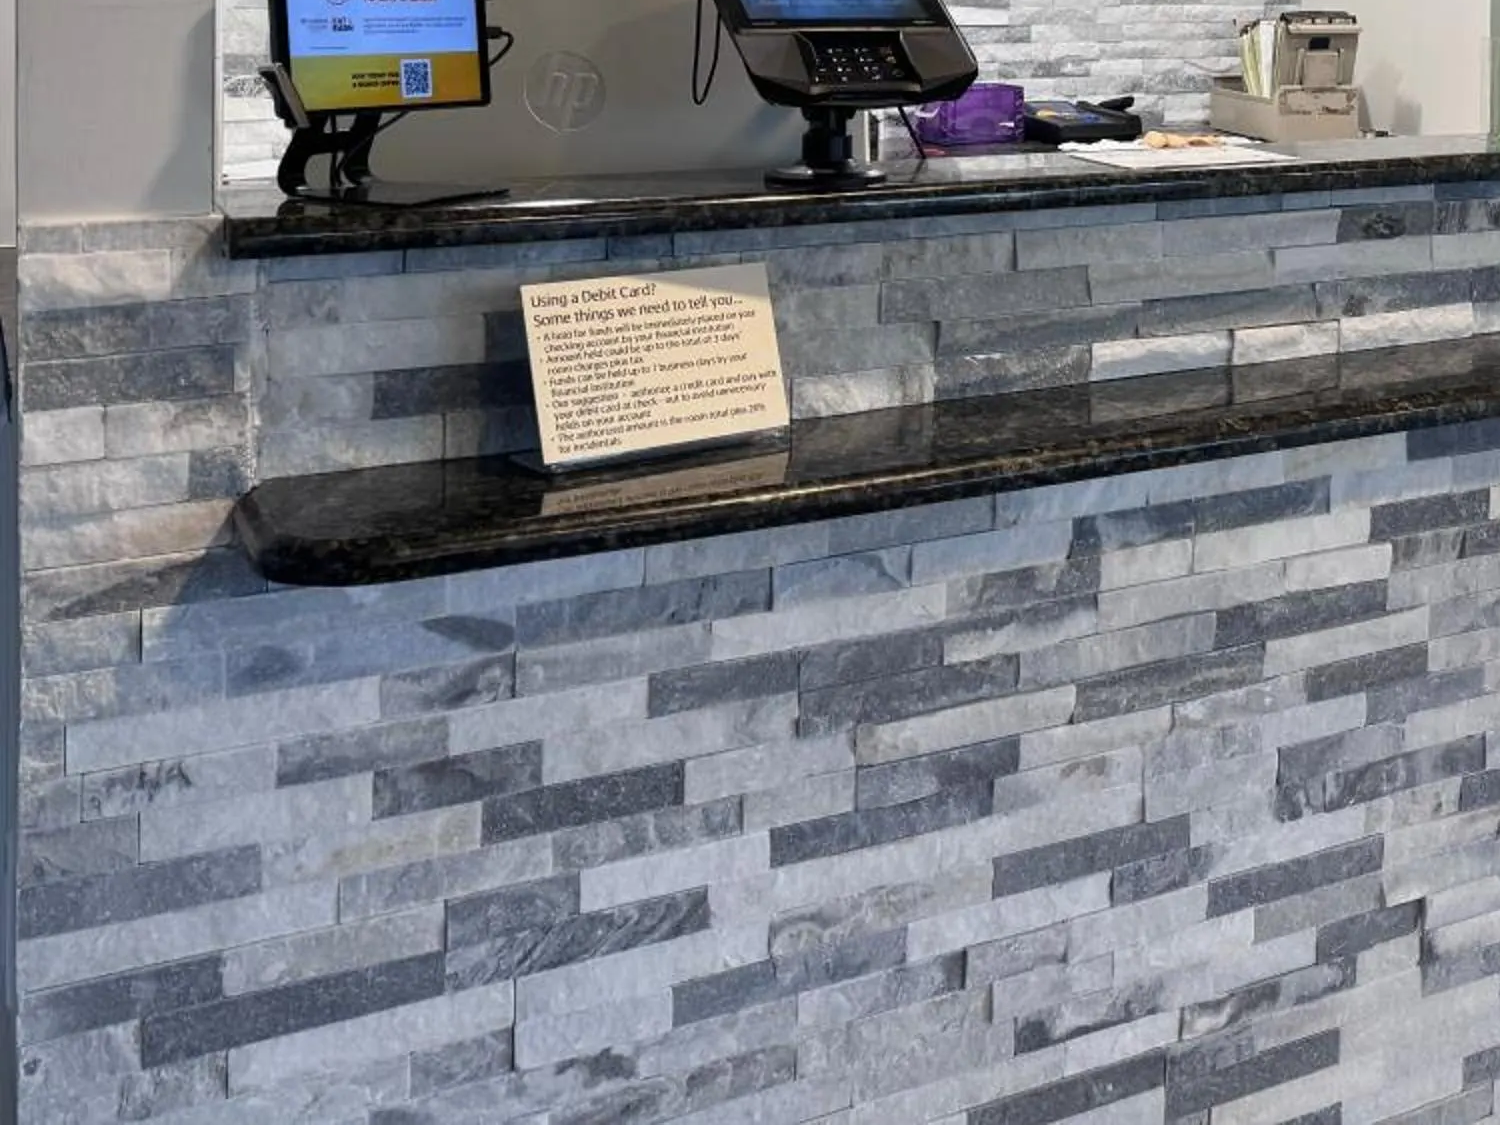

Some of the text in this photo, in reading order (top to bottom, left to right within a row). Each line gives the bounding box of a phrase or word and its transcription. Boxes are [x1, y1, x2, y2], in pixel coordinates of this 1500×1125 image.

[531, 293, 567, 308] Using
[581, 288, 616, 302] Debit
[619, 284, 657, 298] Card?
[533, 312, 570, 326] Some
[574, 307, 614, 324] things
[617, 307, 636, 316] we
[638, 300, 669, 314] need
[673, 300, 686, 310] to
[688, 296, 707, 308] tell
[631, 322, 641, 330] be
[697, 314, 723, 323] placed
[544, 342, 583, 352] checking
[655, 328, 690, 337] financial
[583, 350, 602, 358] held
[604, 347, 628, 355] could
[630, 344, 640, 352] be
[643, 344, 654, 352] up
[549, 376, 575, 385] Funds
[607, 369, 626, 377] held
[695, 357, 715, 368] days
[574, 361, 607, 371] charges
[551, 386, 588, 395] financial
[679, 380, 703, 389] credit
[725, 374, 740, 383] and
[600, 404, 620, 412] card
[681, 393, 689, 401] to
[691, 390, 714, 399] avoid
[558, 432, 573, 442] The
[709, 408, 728, 418] total
